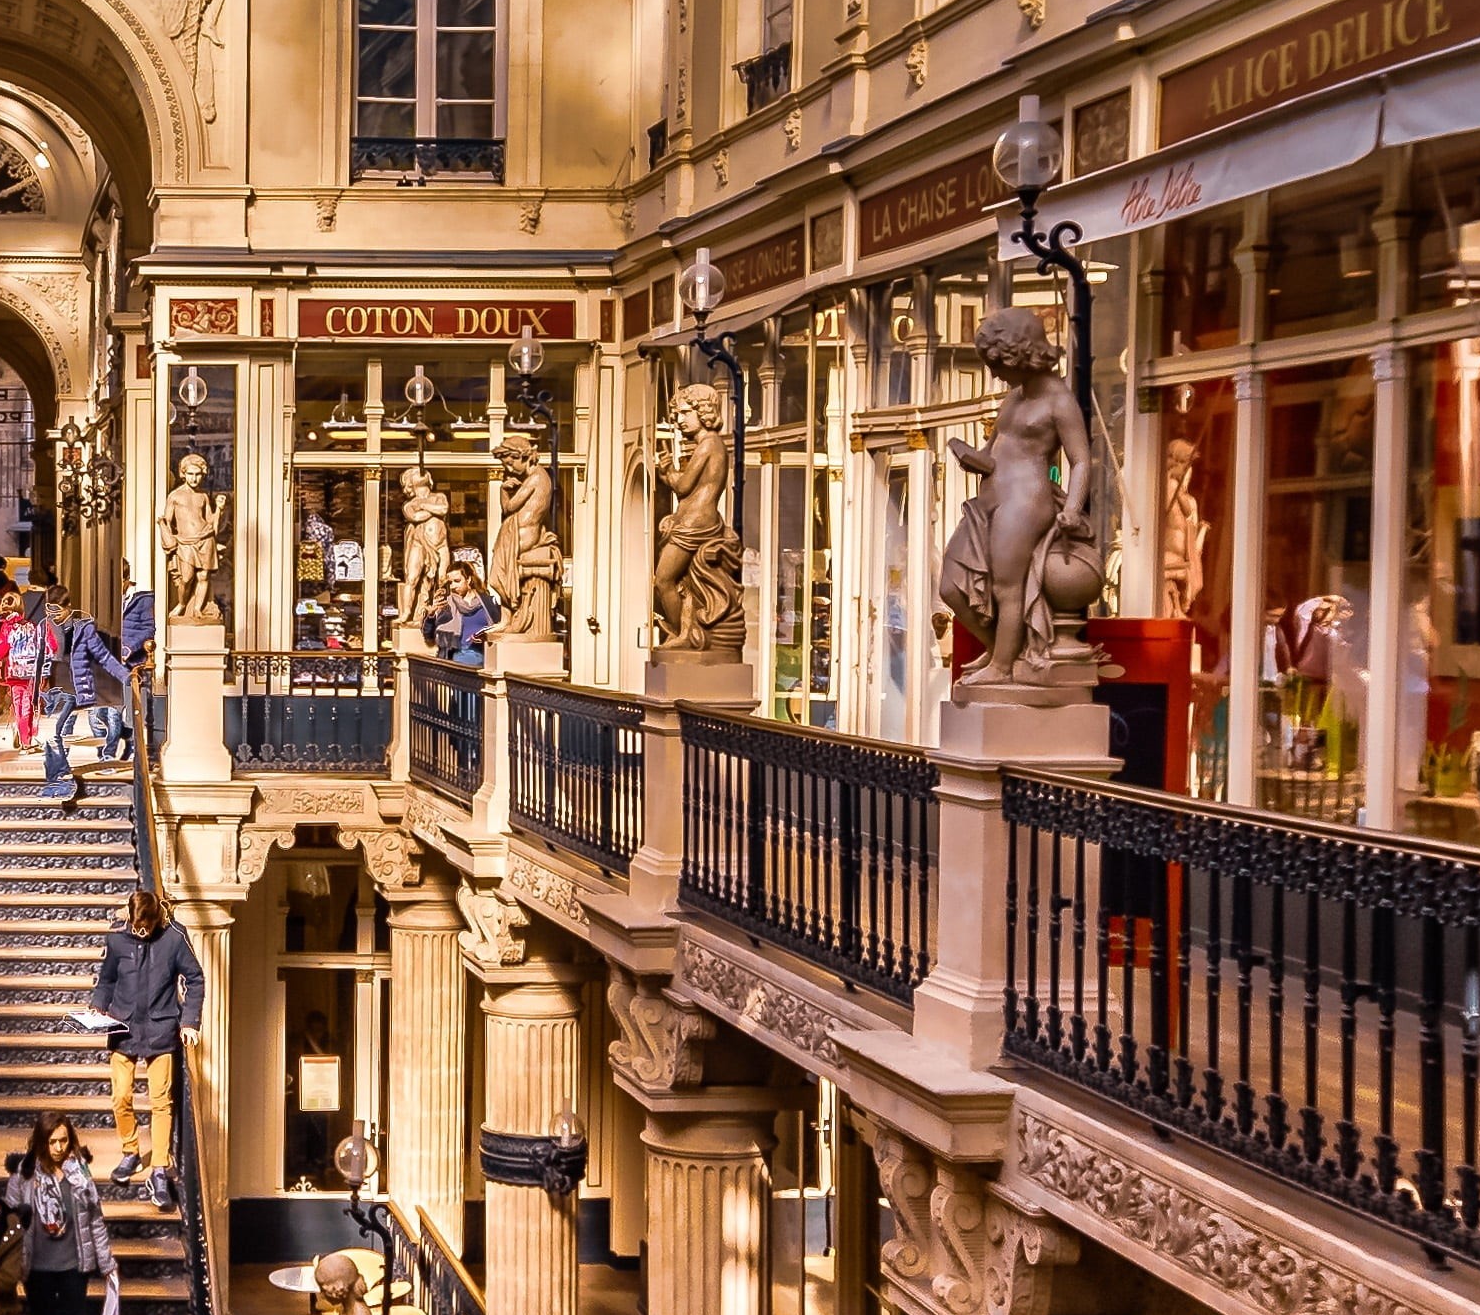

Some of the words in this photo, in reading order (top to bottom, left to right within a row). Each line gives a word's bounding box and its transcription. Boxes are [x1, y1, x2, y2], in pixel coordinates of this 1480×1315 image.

[1205, 40, 1299, 119] ALICE
[872, 204, 892, 243] LA
[897, 177, 958, 234] CHAISE
[749, 239, 798, 285] LONGUE
[325, 306, 436, 335] COTON
[454, 306, 551, 336] DOUX
